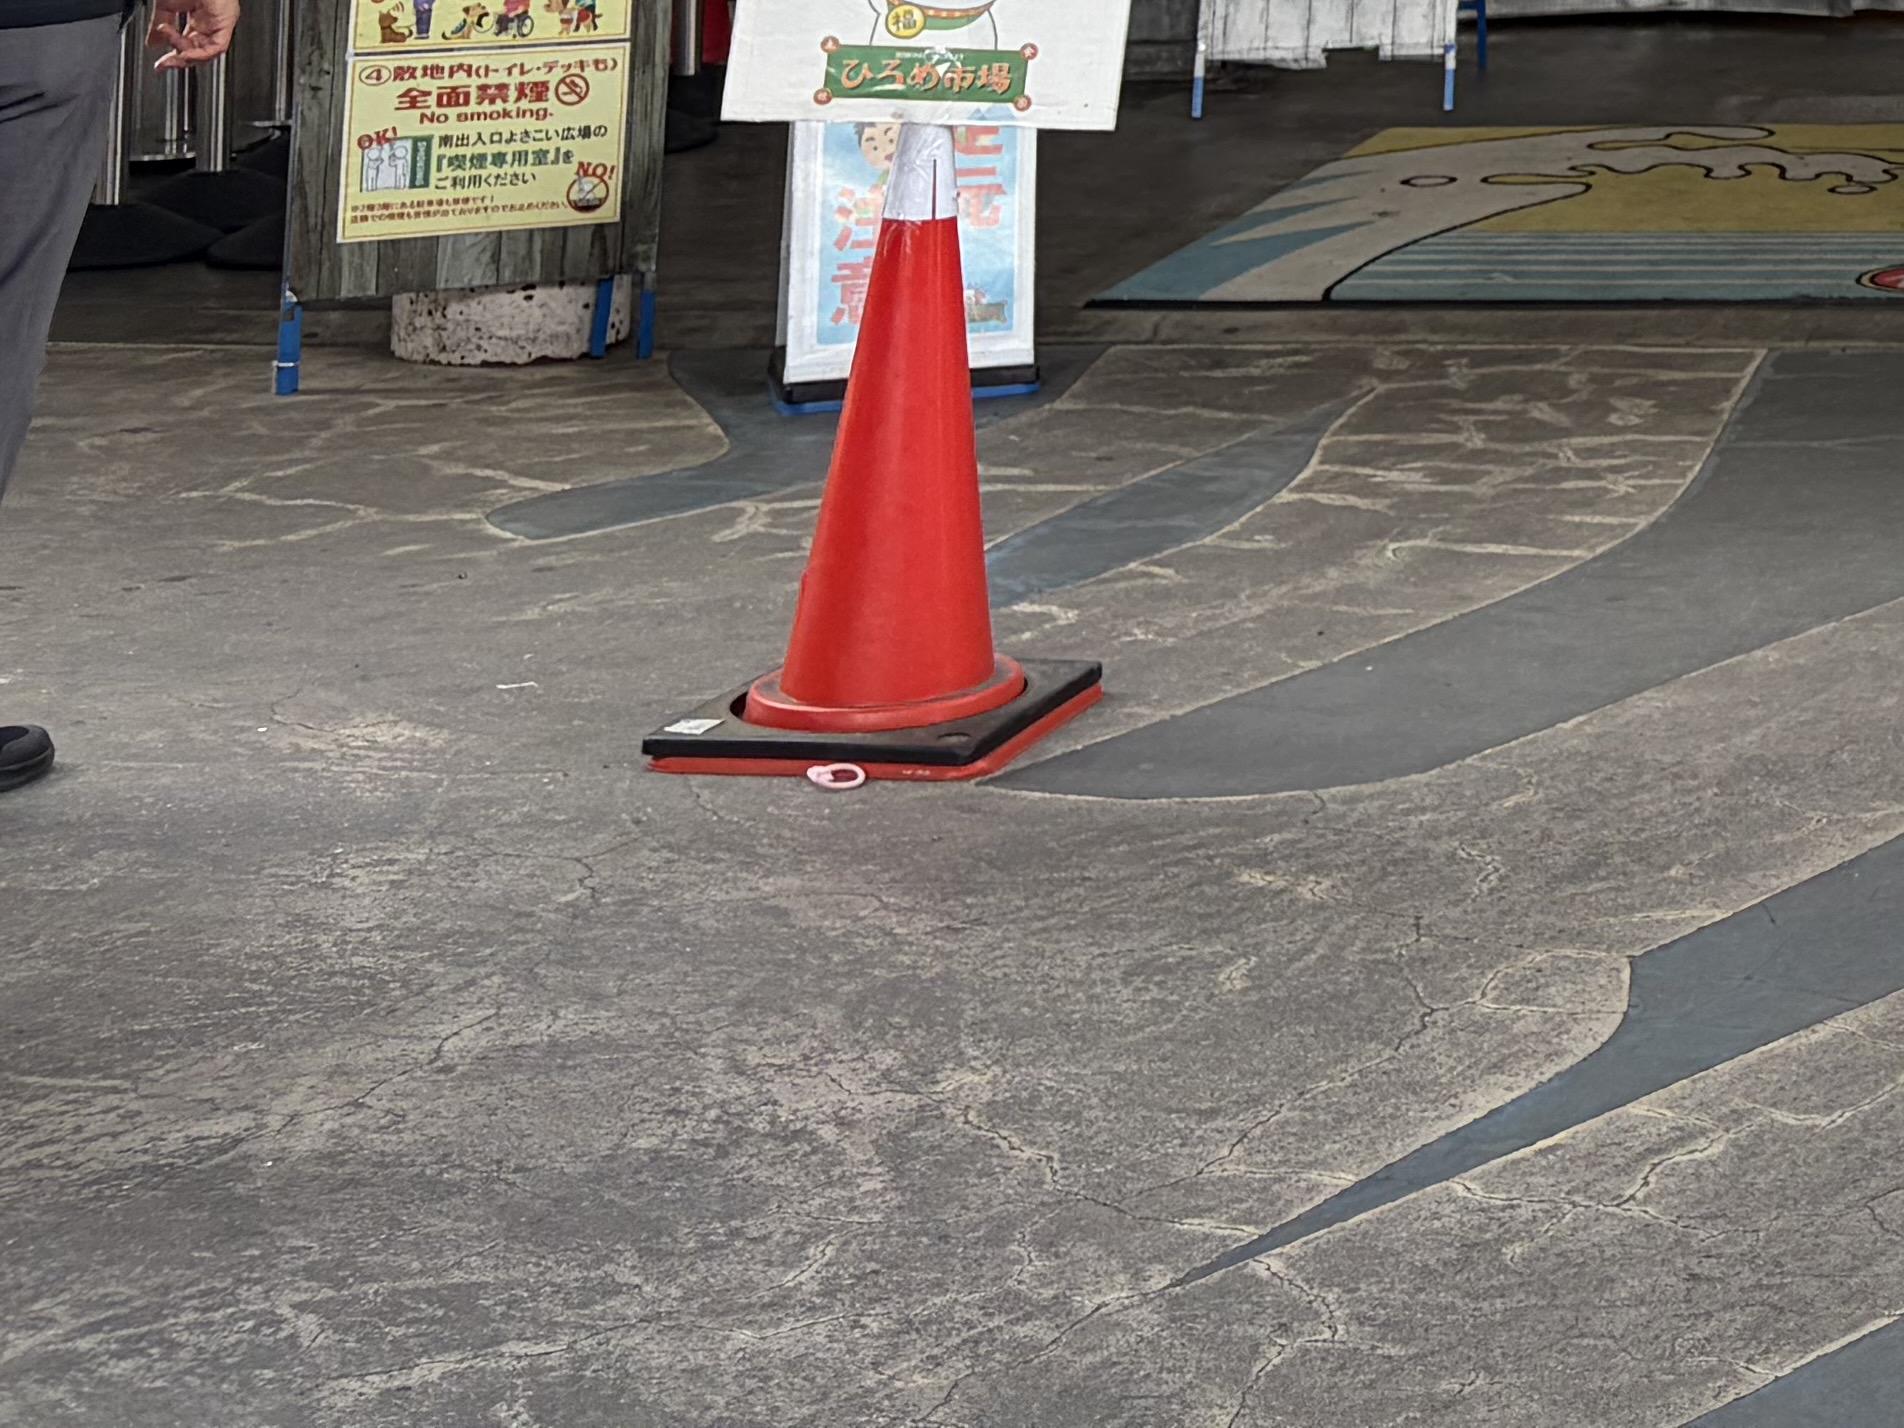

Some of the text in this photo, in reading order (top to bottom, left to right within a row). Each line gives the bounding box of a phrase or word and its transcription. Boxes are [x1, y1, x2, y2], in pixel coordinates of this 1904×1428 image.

[840, 58, 1014, 95] ひろめ市場
[394, 79, 551, 112] 全面禁煙
[418, 110, 450, 125] No
[434, 171, 536, 191] ご利用ください
